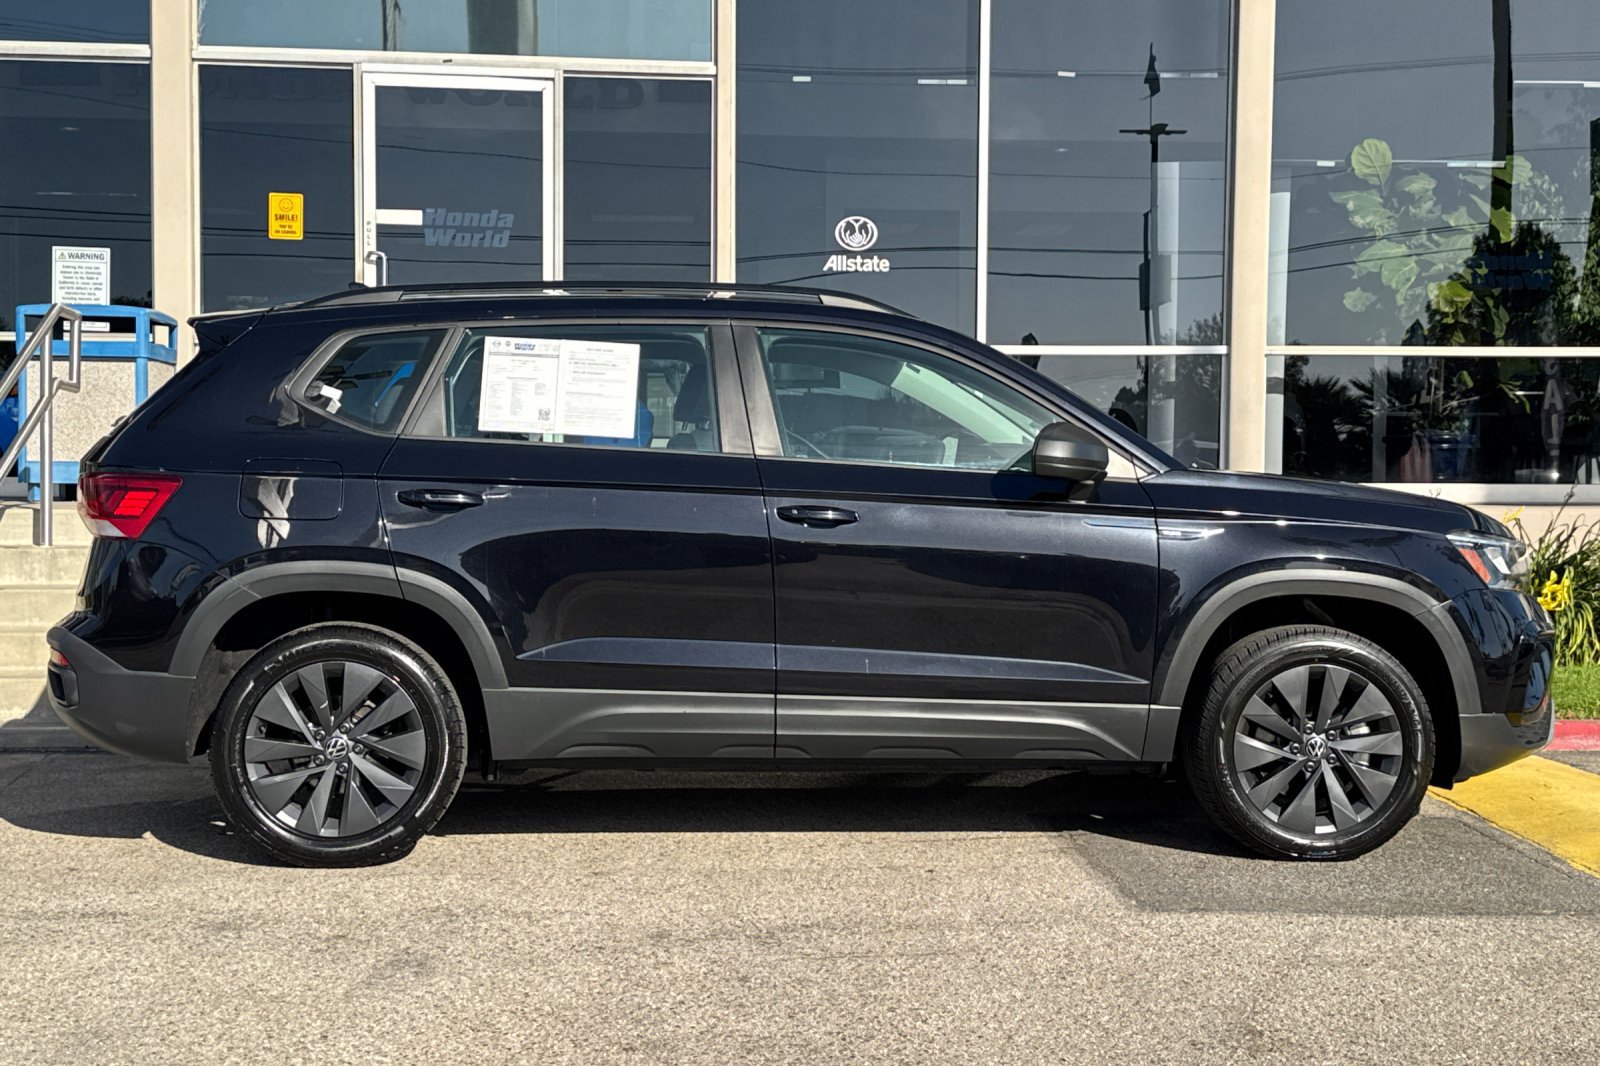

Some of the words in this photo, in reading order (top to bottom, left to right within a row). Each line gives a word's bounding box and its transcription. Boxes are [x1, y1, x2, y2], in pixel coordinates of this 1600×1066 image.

[274, 214, 298, 222] SMILE!
[424, 208, 515, 228] Honda
[424, 228, 511, 248] World
[68, 252, 105, 260] WARNING
[823, 255, 890, 272] Allstate
